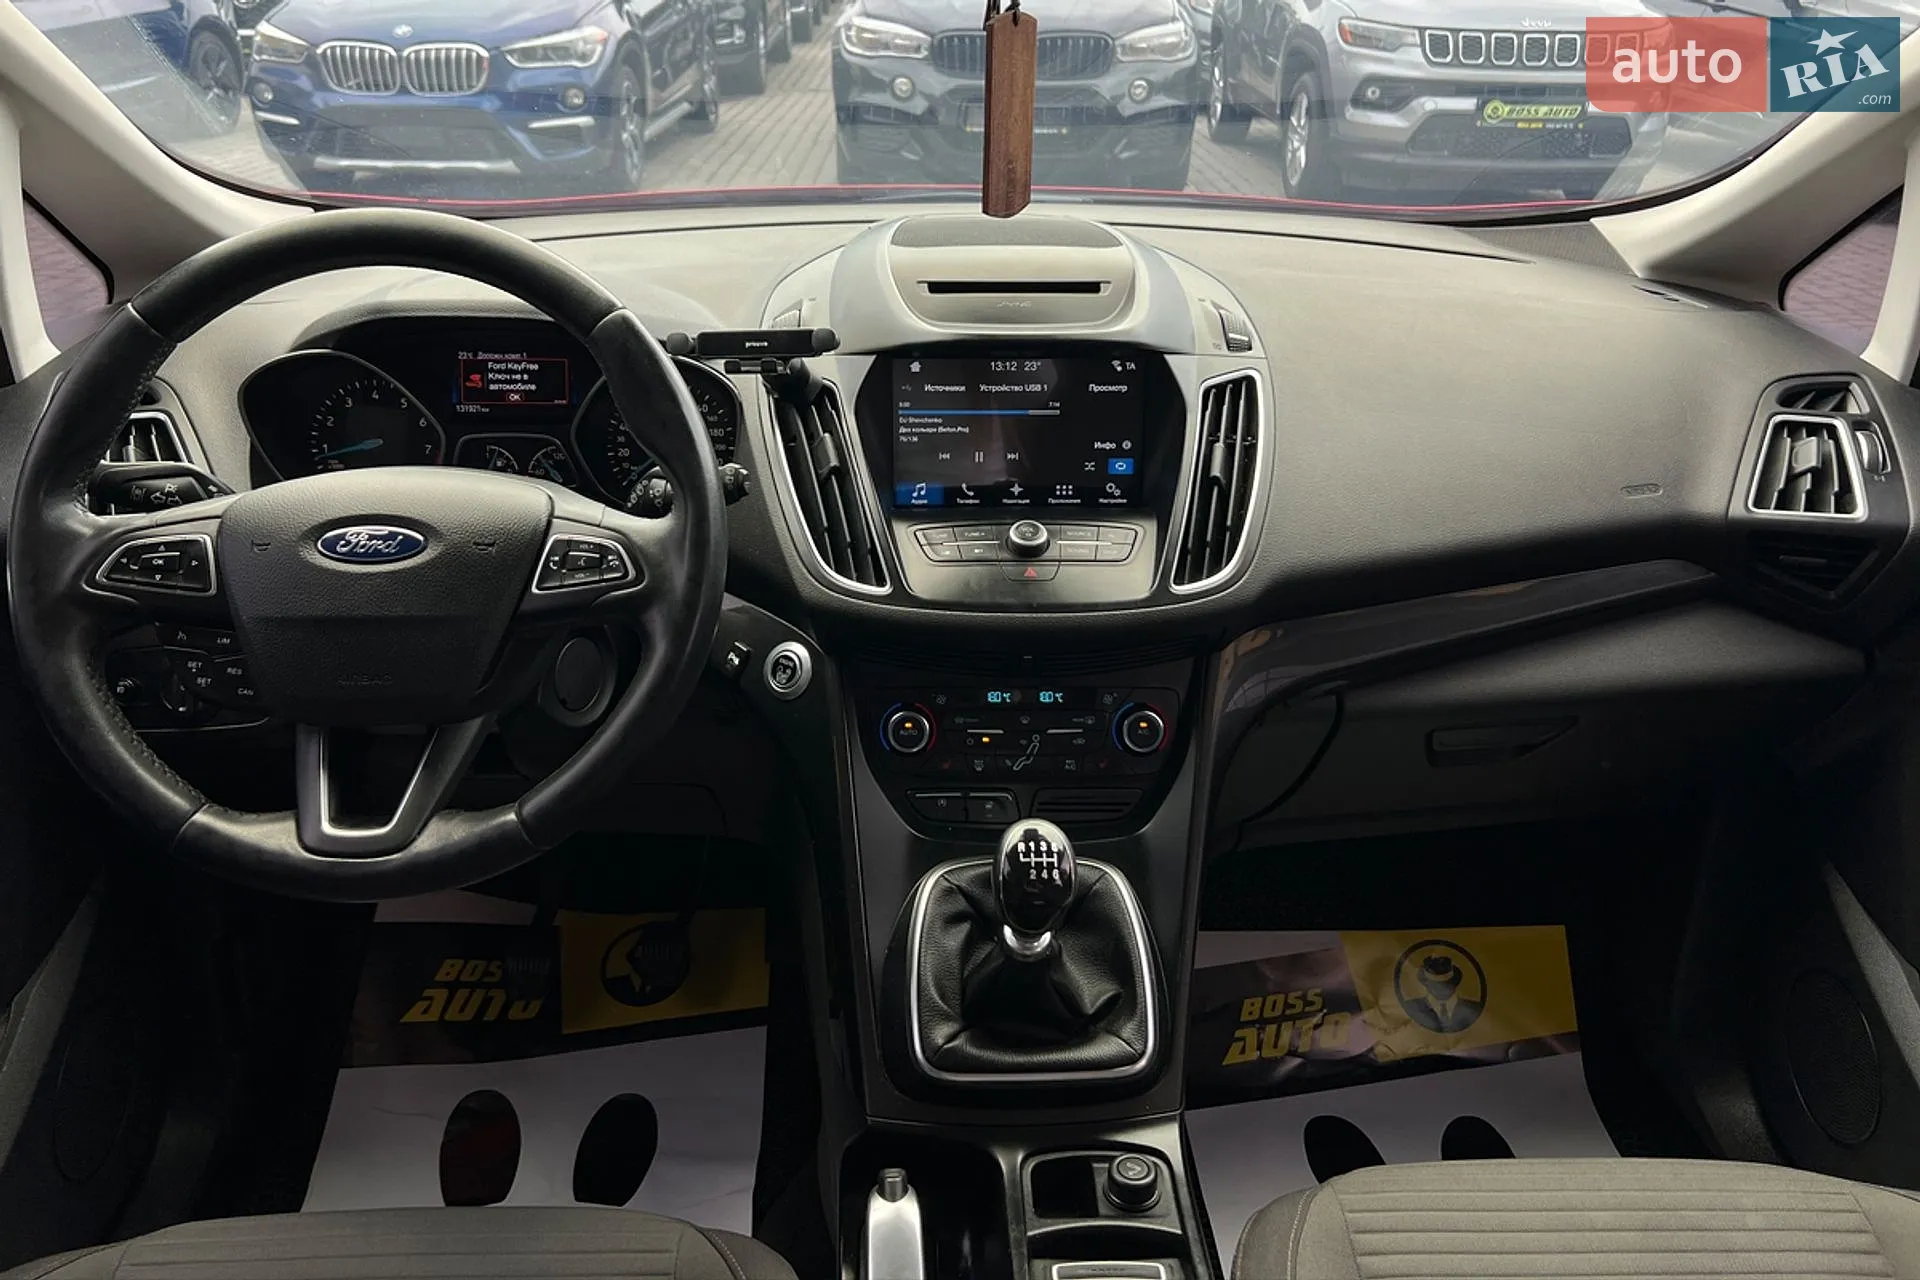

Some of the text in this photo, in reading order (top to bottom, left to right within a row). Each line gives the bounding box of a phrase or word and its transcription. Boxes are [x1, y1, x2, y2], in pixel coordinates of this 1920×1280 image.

[488, 362, 539, 371] Ford KeyFree
[990, 361, 1042, 372] 13:12 23°
[1125, 361, 1136, 371] TA
[488, 373, 510, 381] Ключ
[488, 383, 537, 391] автомобиле
[924, 383, 967, 393] Источники
[979, 383, 1024, 393] Устройство
[1025, 384, 1042, 392] USB
[1088, 383, 1129, 393] Просмотр
[372, 390, 380, 400] 4
[345, 398, 353, 408] 3
[400, 398, 408, 408] 5
[326, 416, 335, 427] 2
[419, 418, 428, 427] 6
[322, 444, 329, 454] 1
[425, 445, 432, 455] 7
[1094, 441, 1116, 450] Инфо
[617, 448, 630, 457] 20
[336, 529, 403, 554] Ford
[151, 558, 165, 566] OK
[217, 637, 231, 645] LIM
[226, 667, 243, 675] RES
[196, 677, 212, 685] SET
[237, 687, 254, 696] CAN
[899, 728, 918, 736] AUTO
[1017, 841, 1026, 853] R
[1028, 840, 1036, 852] 1
[1039, 840, 1048, 852] 3
[1029, 868, 1061, 880] 2 4 6
[433, 958, 504, 982] BOS
[1240, 988, 1324, 1022] BOSS
[1222, 1012, 1352, 1066] AUTO
